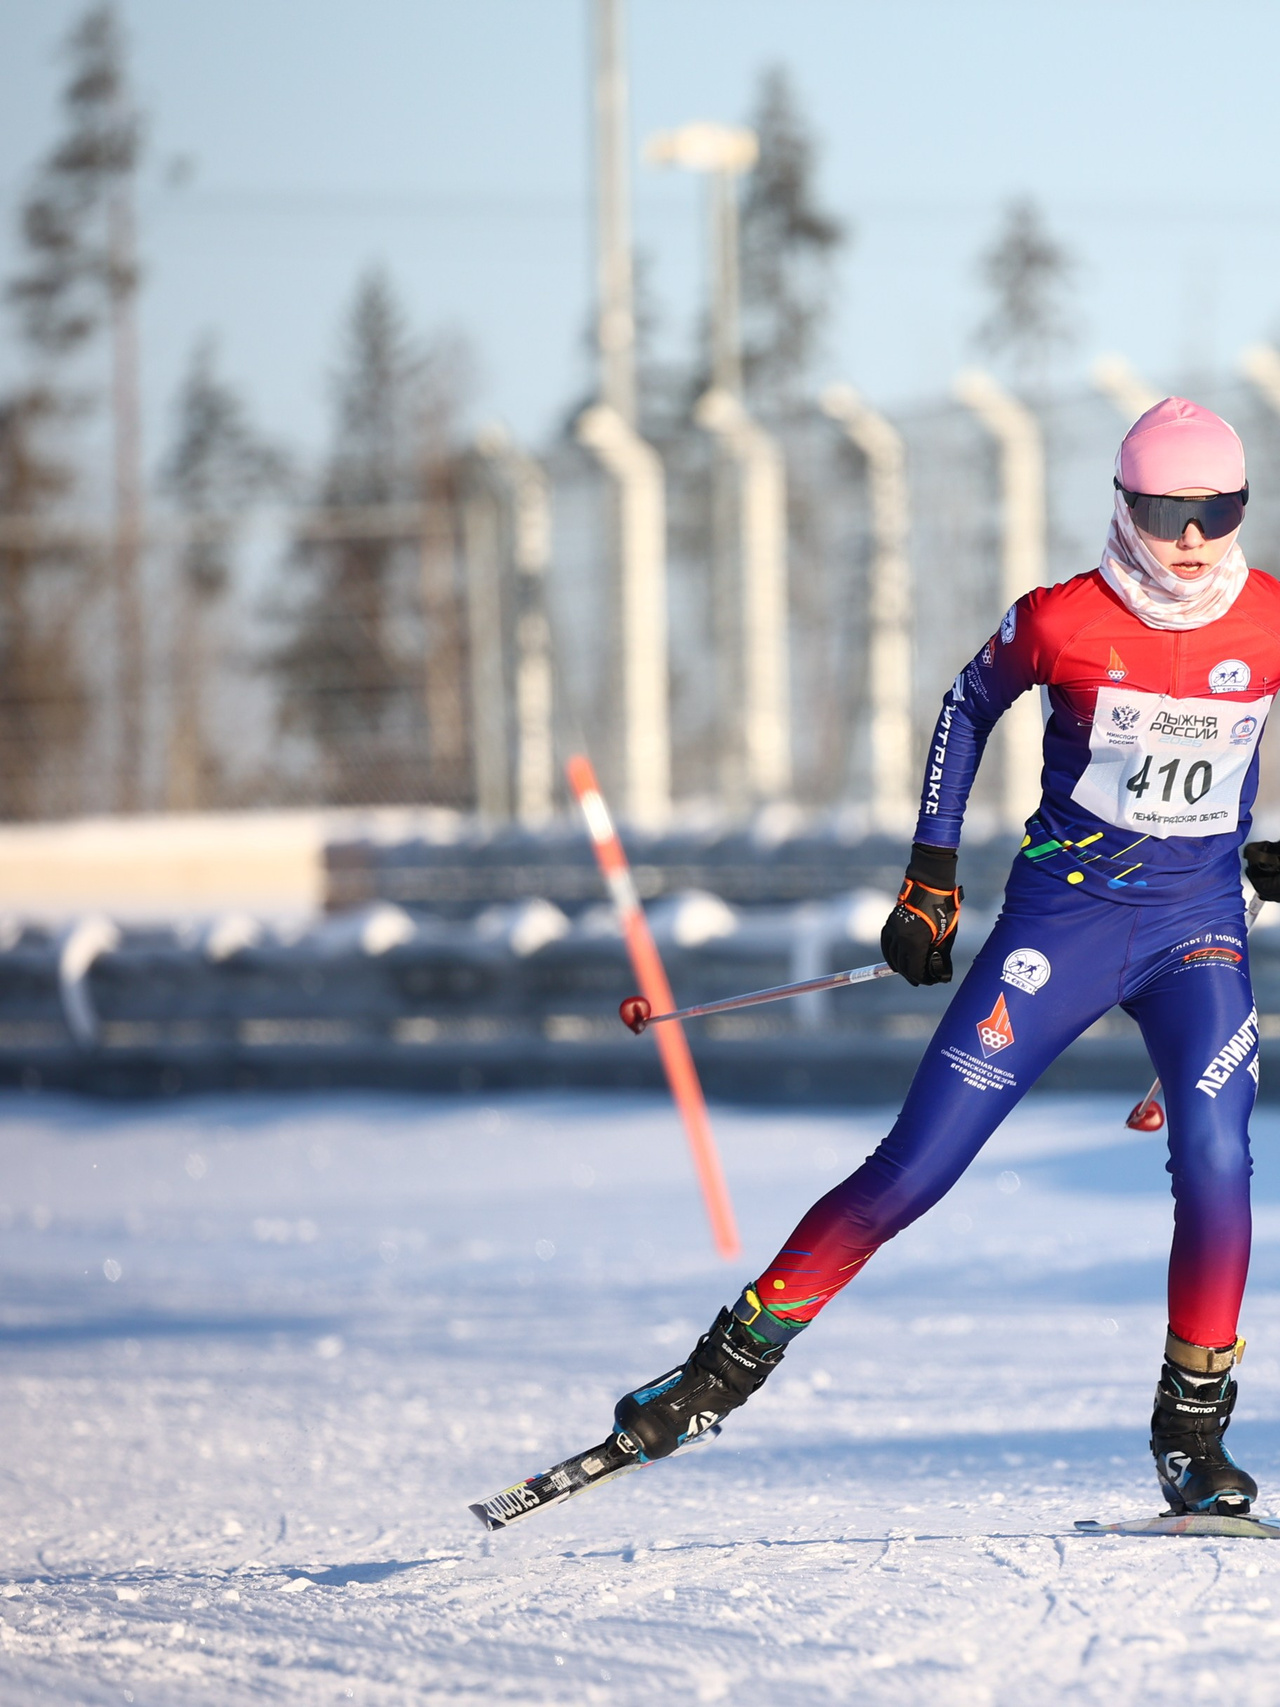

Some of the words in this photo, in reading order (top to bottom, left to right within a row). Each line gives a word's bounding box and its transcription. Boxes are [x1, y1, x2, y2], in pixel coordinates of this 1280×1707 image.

[1155, 711, 1218, 728] ЛЫЖНЯ
[1106, 731, 1139, 740] МИНСПОРТ
[1150, 722, 1218, 740] РОССИИ
[1126, 755, 1213, 805] 410
[1199, 810, 1228, 822] ОБЛАСТЬ
[1195, 1006, 1260, 1099] ЛЕНИНГР
